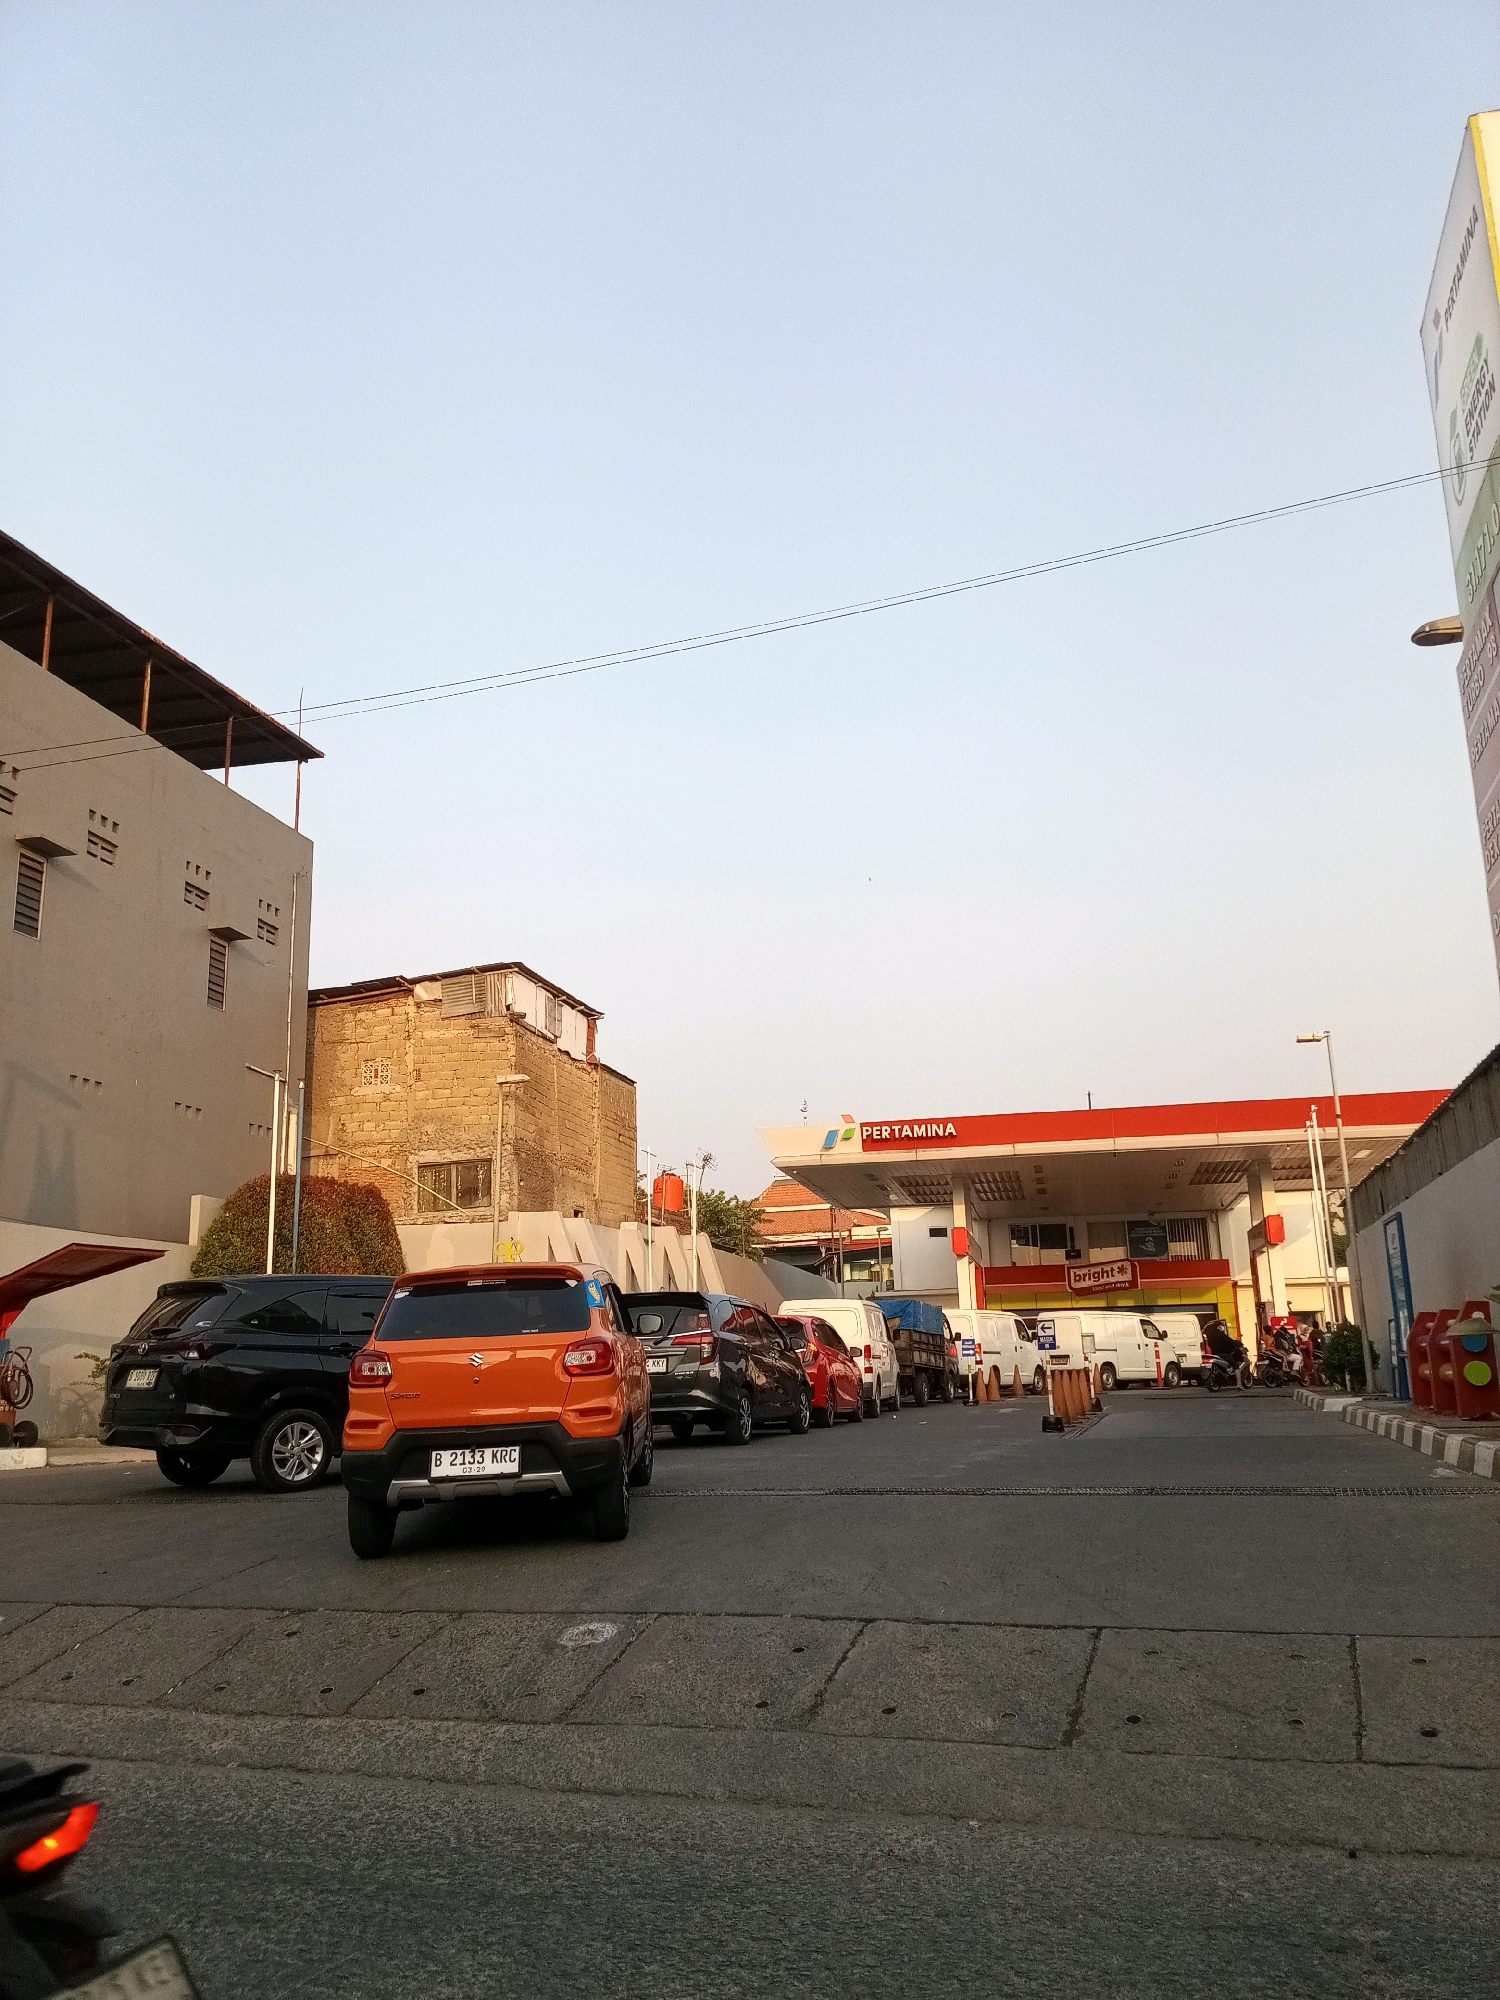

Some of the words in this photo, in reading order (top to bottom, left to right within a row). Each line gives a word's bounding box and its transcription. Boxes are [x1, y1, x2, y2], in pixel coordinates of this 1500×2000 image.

[1444, 204, 1479, 333] PERTAMINA
[1465, 348, 1489, 437] ENERGY
[1469, 372, 1496, 461] STATION
[1460, 604, 1494, 694] PERTAMAX
[1464, 664, 1485, 719] TURBO
[1471, 691, 1500, 769] PERTAMA
[862, 1122, 957, 1140] PERTAMINA
[1073, 1266, 1115, 1283] bright
[434, 1452, 443, 1467] B
[449, 1449, 486, 1466] 2133
[491, 1448, 517, 1464] KRC
